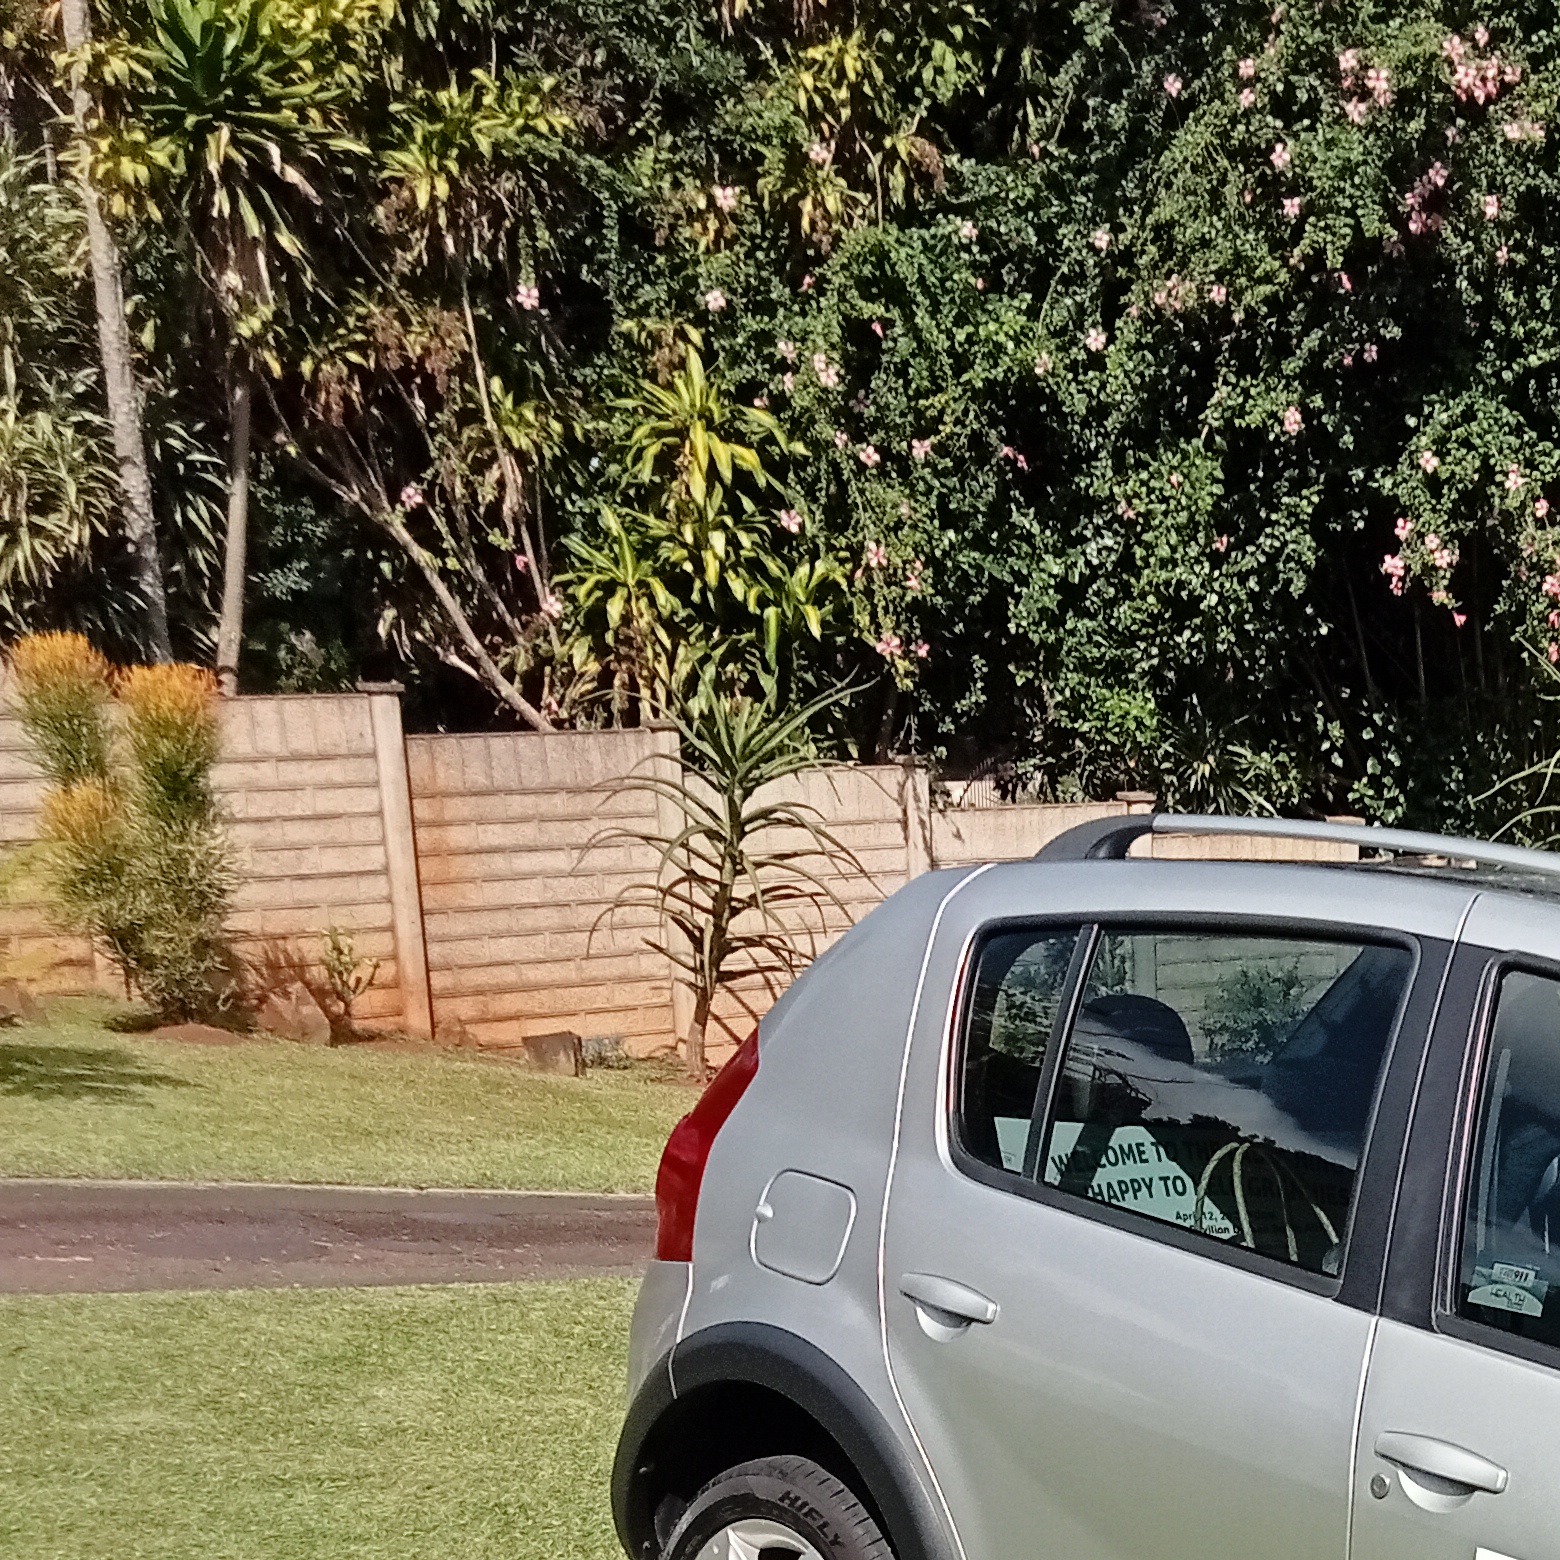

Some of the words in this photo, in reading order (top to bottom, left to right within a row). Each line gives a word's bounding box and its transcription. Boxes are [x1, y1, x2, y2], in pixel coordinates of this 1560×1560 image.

[1091, 1177, 1153, 1203] HAPPY
[1159, 1175, 1187, 1197] TO
[777, 1489, 847, 1548] HIFLY
